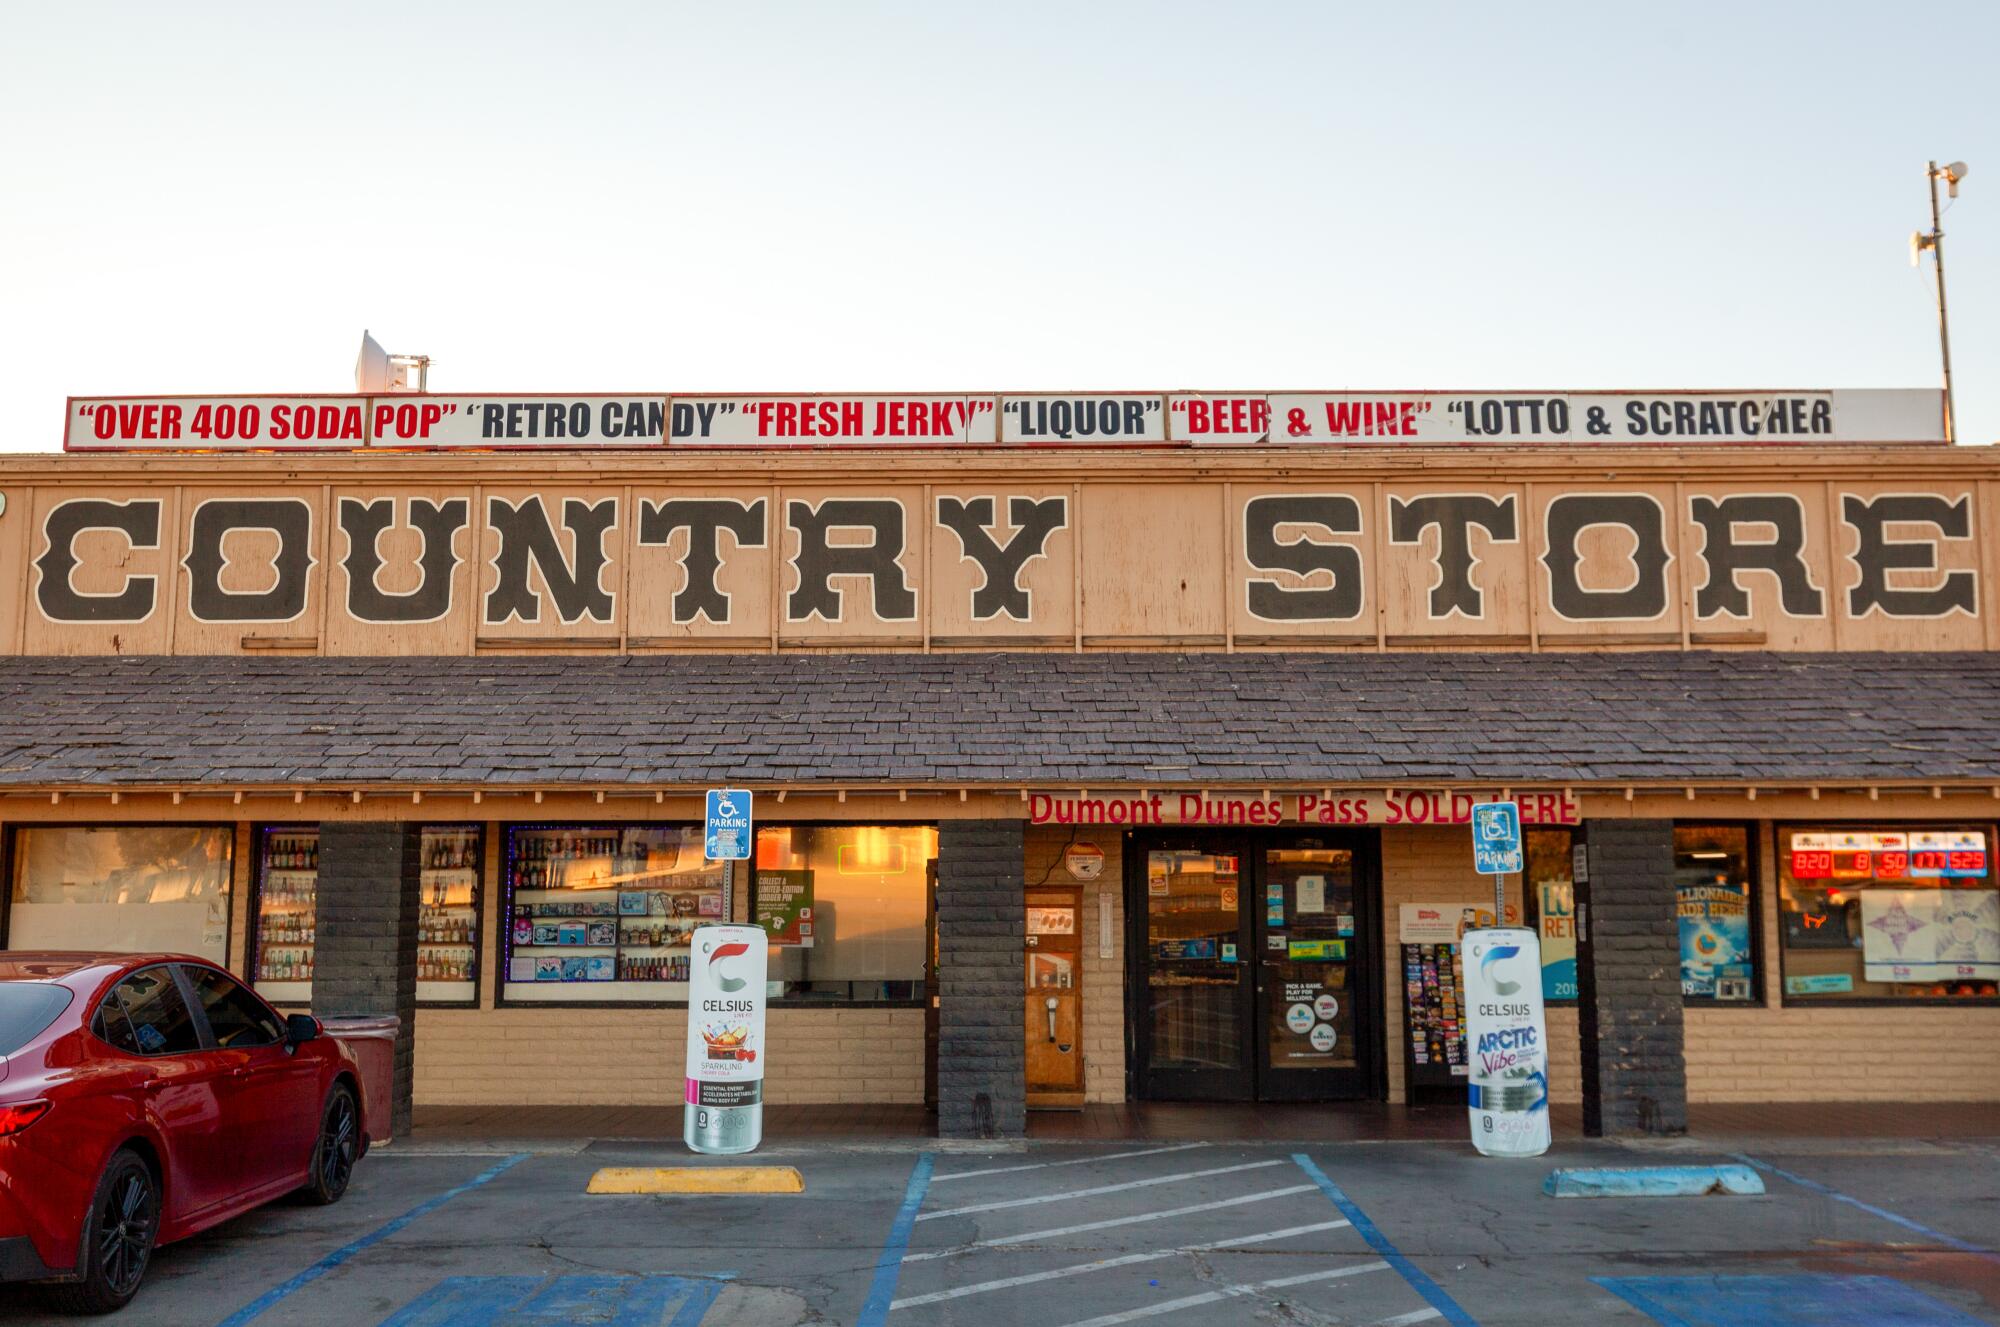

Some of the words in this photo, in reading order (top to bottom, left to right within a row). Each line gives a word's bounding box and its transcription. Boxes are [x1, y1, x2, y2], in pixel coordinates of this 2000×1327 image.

[190, 404, 260, 440] 400
[269, 404, 363, 440] SODA
[1287, 407, 1312, 436] &
[1586, 406, 1612, 436] &
[1625, 399, 1832, 436] SCRATCHER
[33, 493, 1069, 625] COUNTRY
[1245, 491, 1979, 624] STORE
[1031, 794, 1163, 824] Dumont
[1180, 794, 1282, 824] Dunes
[1300, 794, 1369, 824] Pass
[1385, 790, 1474, 824] SOLD
[710, 818, 747, 828] PARKING
[1795, 853, 1830, 869] 820
[1856, 853, 1869, 869] 8
[1883, 853, 1907, 869] 50
[1916, 853, 1946, 869] 177
[703, 1000, 753, 1012] CELSIUS
[1480, 1003, 1530, 1016] CELSIUS
[1477, 1026, 1537, 1055] ARCTIC
[701, 1062, 742, 1071] SPARKLING
[1482, 1050, 1516, 1074] Vibe
